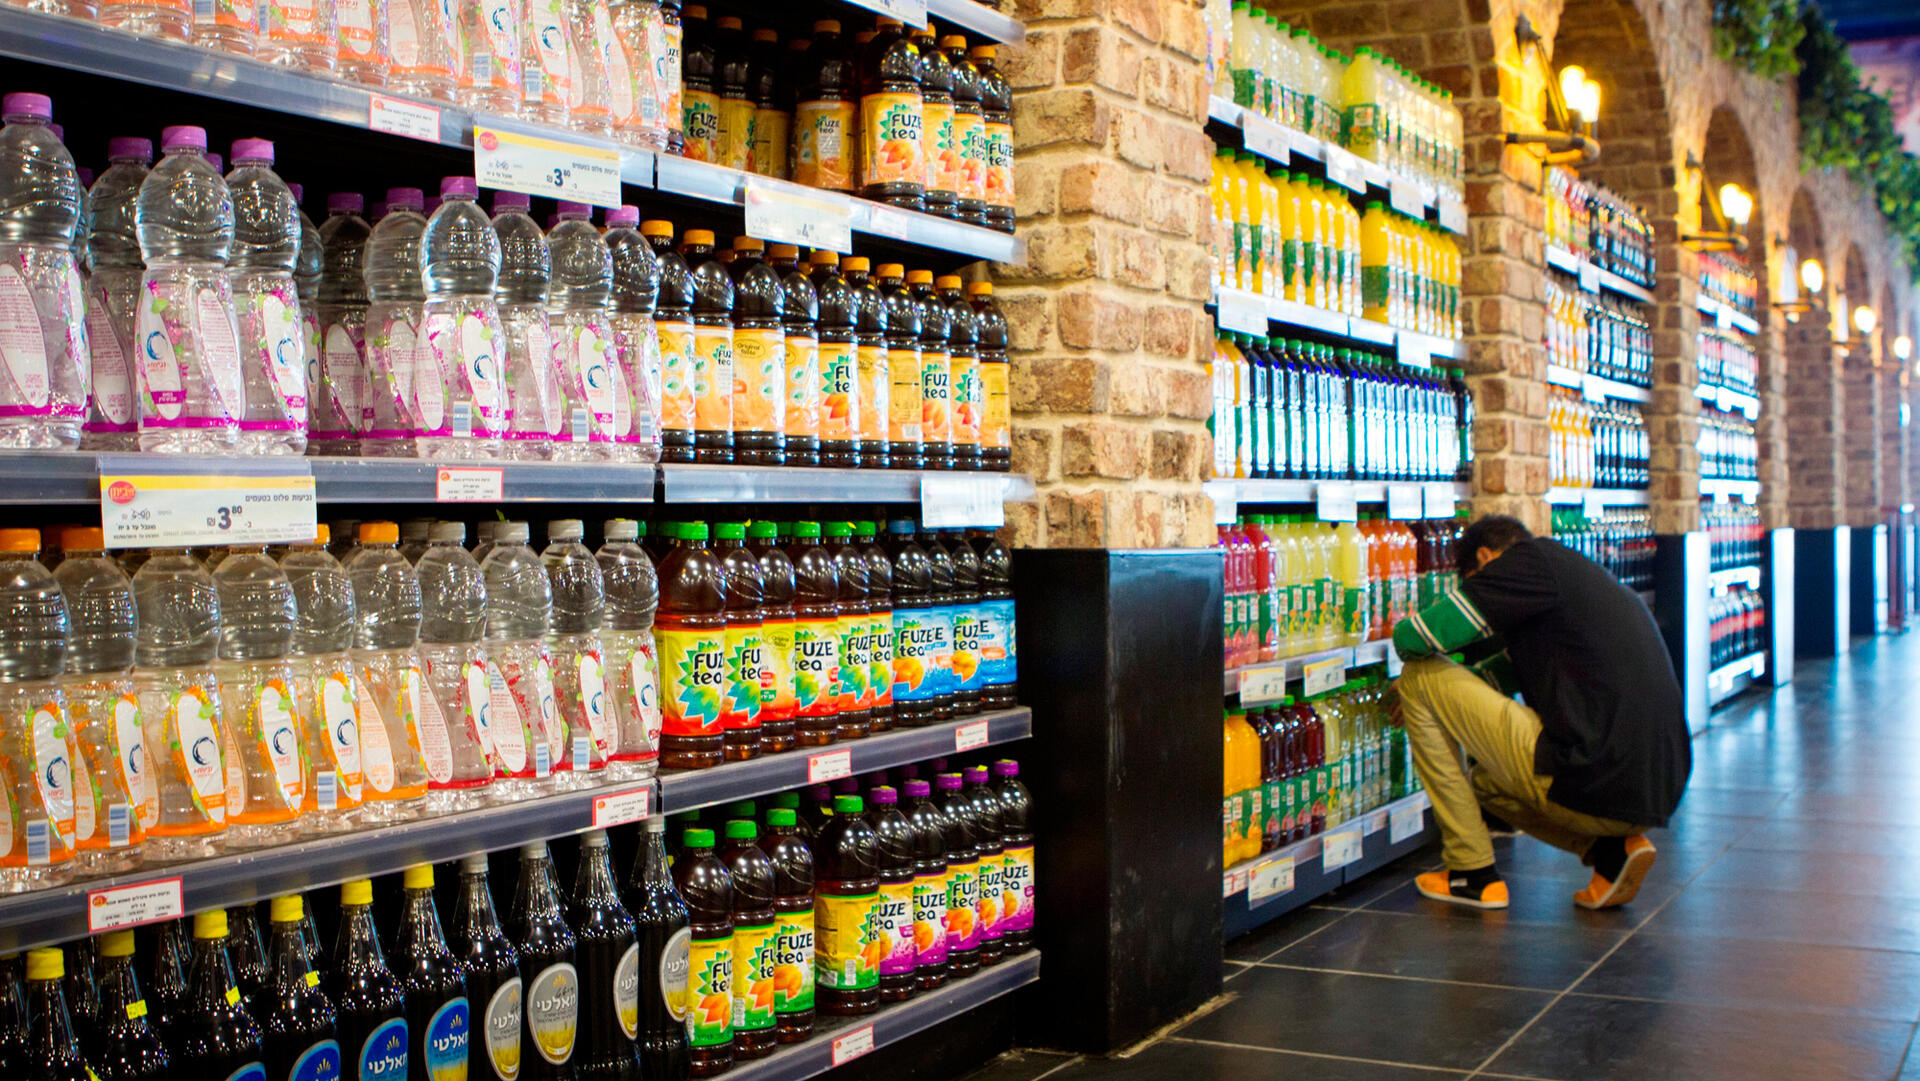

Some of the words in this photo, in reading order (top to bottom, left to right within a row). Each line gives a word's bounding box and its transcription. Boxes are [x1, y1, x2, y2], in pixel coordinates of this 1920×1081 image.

[689, 111, 718, 130] FUZE
[892, 113, 921, 130] FUZE
[688, 126, 711, 139] tea
[891, 128, 917, 140] tea
[989, 142, 1014, 157] FUZE
[988, 154, 1009, 168] tea
[554, 168, 564, 187] 3
[924, 387, 947, 399] tea
[273, 494, 289, 502] פלוס
[217, 506, 232, 530] 3
[900, 629, 933, 645] FUZE
[795, 641, 833, 657] FUZE
[900, 645, 925, 657] tea
[953, 639, 979, 651] tea
[694, 652, 723, 670] FUZ
[847, 651, 867, 666] tea
[692, 670, 722, 685] tea
[913, 893, 946, 908] FUZE
[979, 887, 999, 899] tea
[777, 932, 813, 952] FUZE
[776, 951, 804, 965] tea
